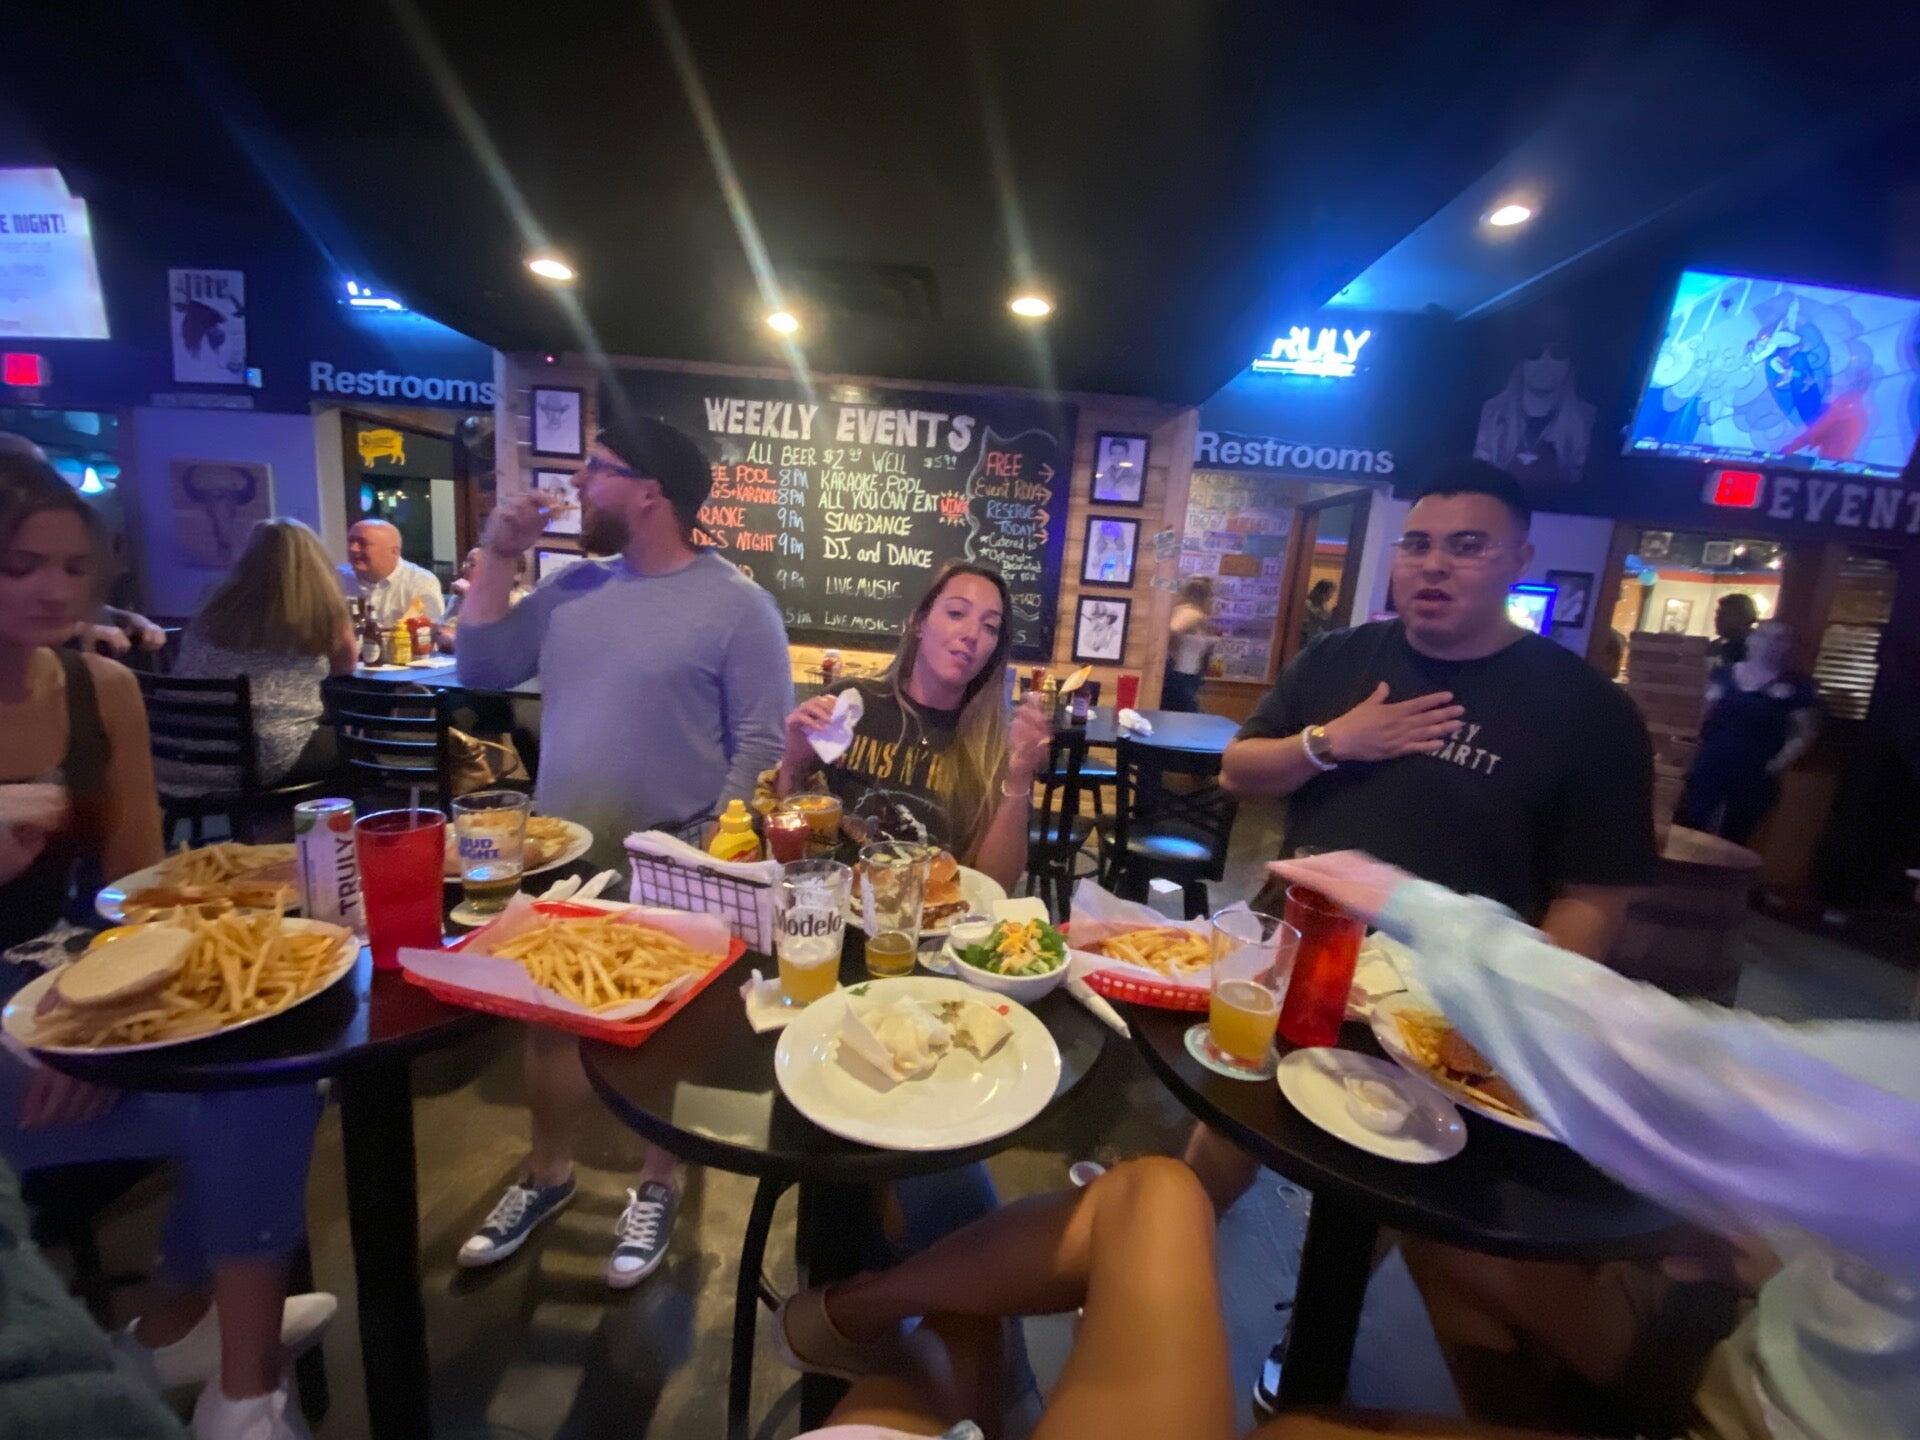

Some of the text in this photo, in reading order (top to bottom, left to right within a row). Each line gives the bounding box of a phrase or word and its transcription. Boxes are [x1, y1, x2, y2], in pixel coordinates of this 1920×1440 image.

[309, 361, 496, 405] Restrooms
[704, 397, 976, 453] WEEKLY EVENTS
[746, 441, 773, 466] ALL
[780, 445, 817, 467] BEER
[872, 450, 907, 475] WELL
[986, 451, 1024, 477] FREE
[1193, 431, 1396, 474] Restrooms
[735, 464, 777, 484] POOL
[696, 506, 746, 528] RAOKE
[818, 490, 844, 510] ALL
[851, 490, 879, 510] YOU
[912, 493, 939, 513] EAT
[736, 530, 777, 552] NIGHT
[856, 541, 881, 564] and
[886, 543, 934, 568] DANCE
[838, 734, 900, 779] UNS
[1424, 741, 1502, 775] ARTT
[460, 837, 494, 849] BUD
[335, 837, 358, 917] TRULY
[773, 904, 842, 938] Modelo
